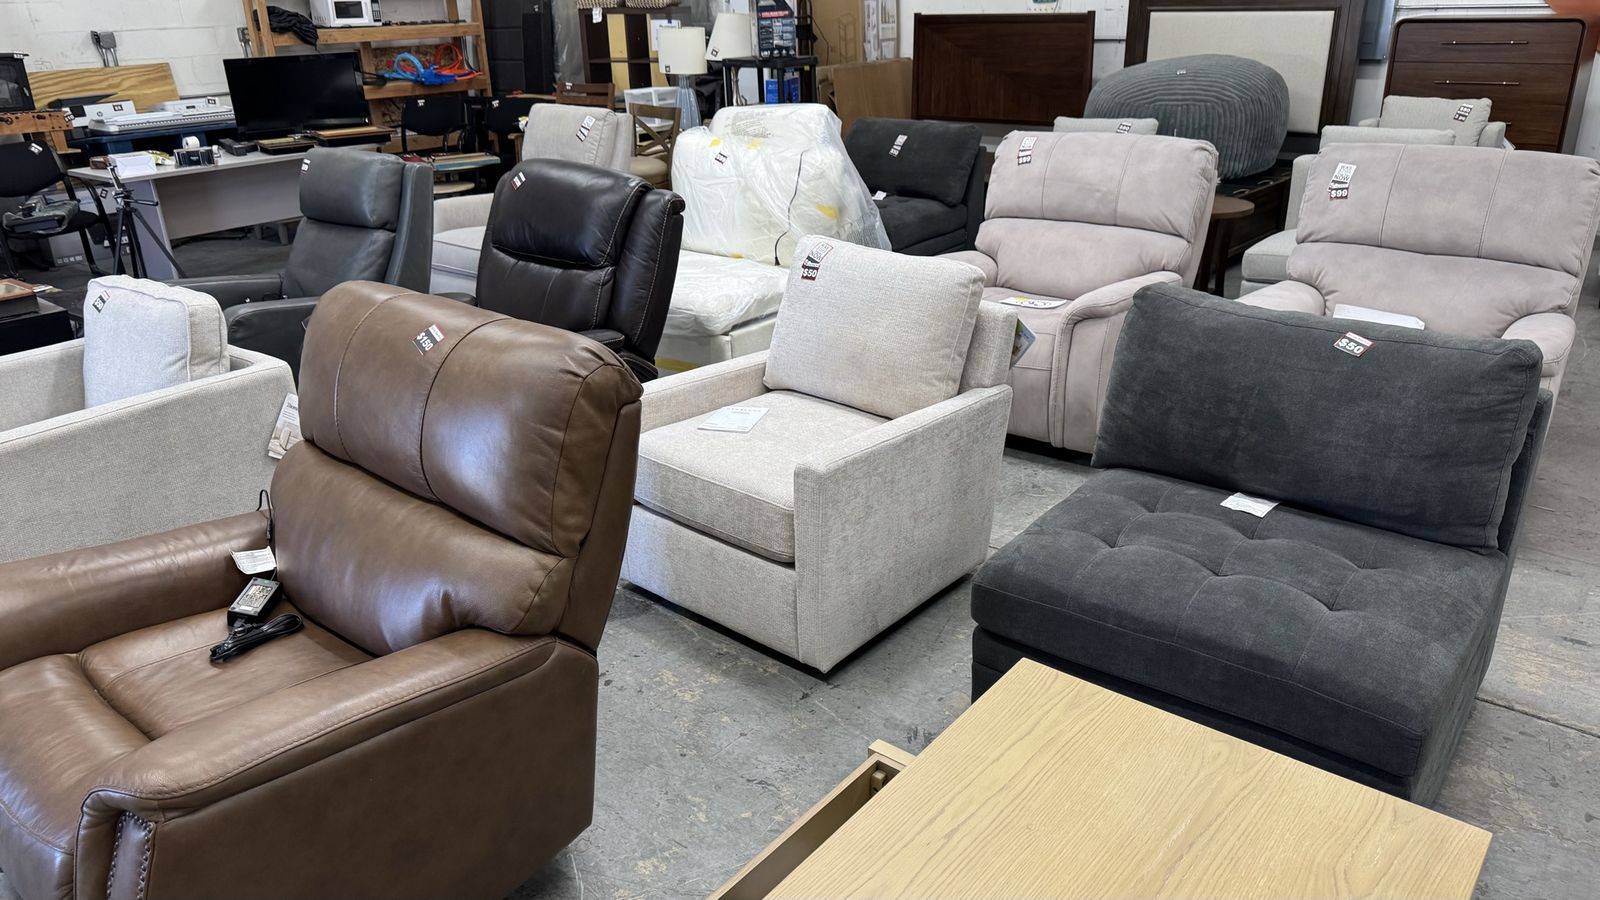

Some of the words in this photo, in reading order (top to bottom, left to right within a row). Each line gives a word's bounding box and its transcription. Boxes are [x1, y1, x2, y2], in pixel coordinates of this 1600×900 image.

[1330, 189, 1348, 198] $99
[802, 268, 817, 278] $50
[416, 332, 434, 352] $150
[1338, 338, 1365, 354] $50
